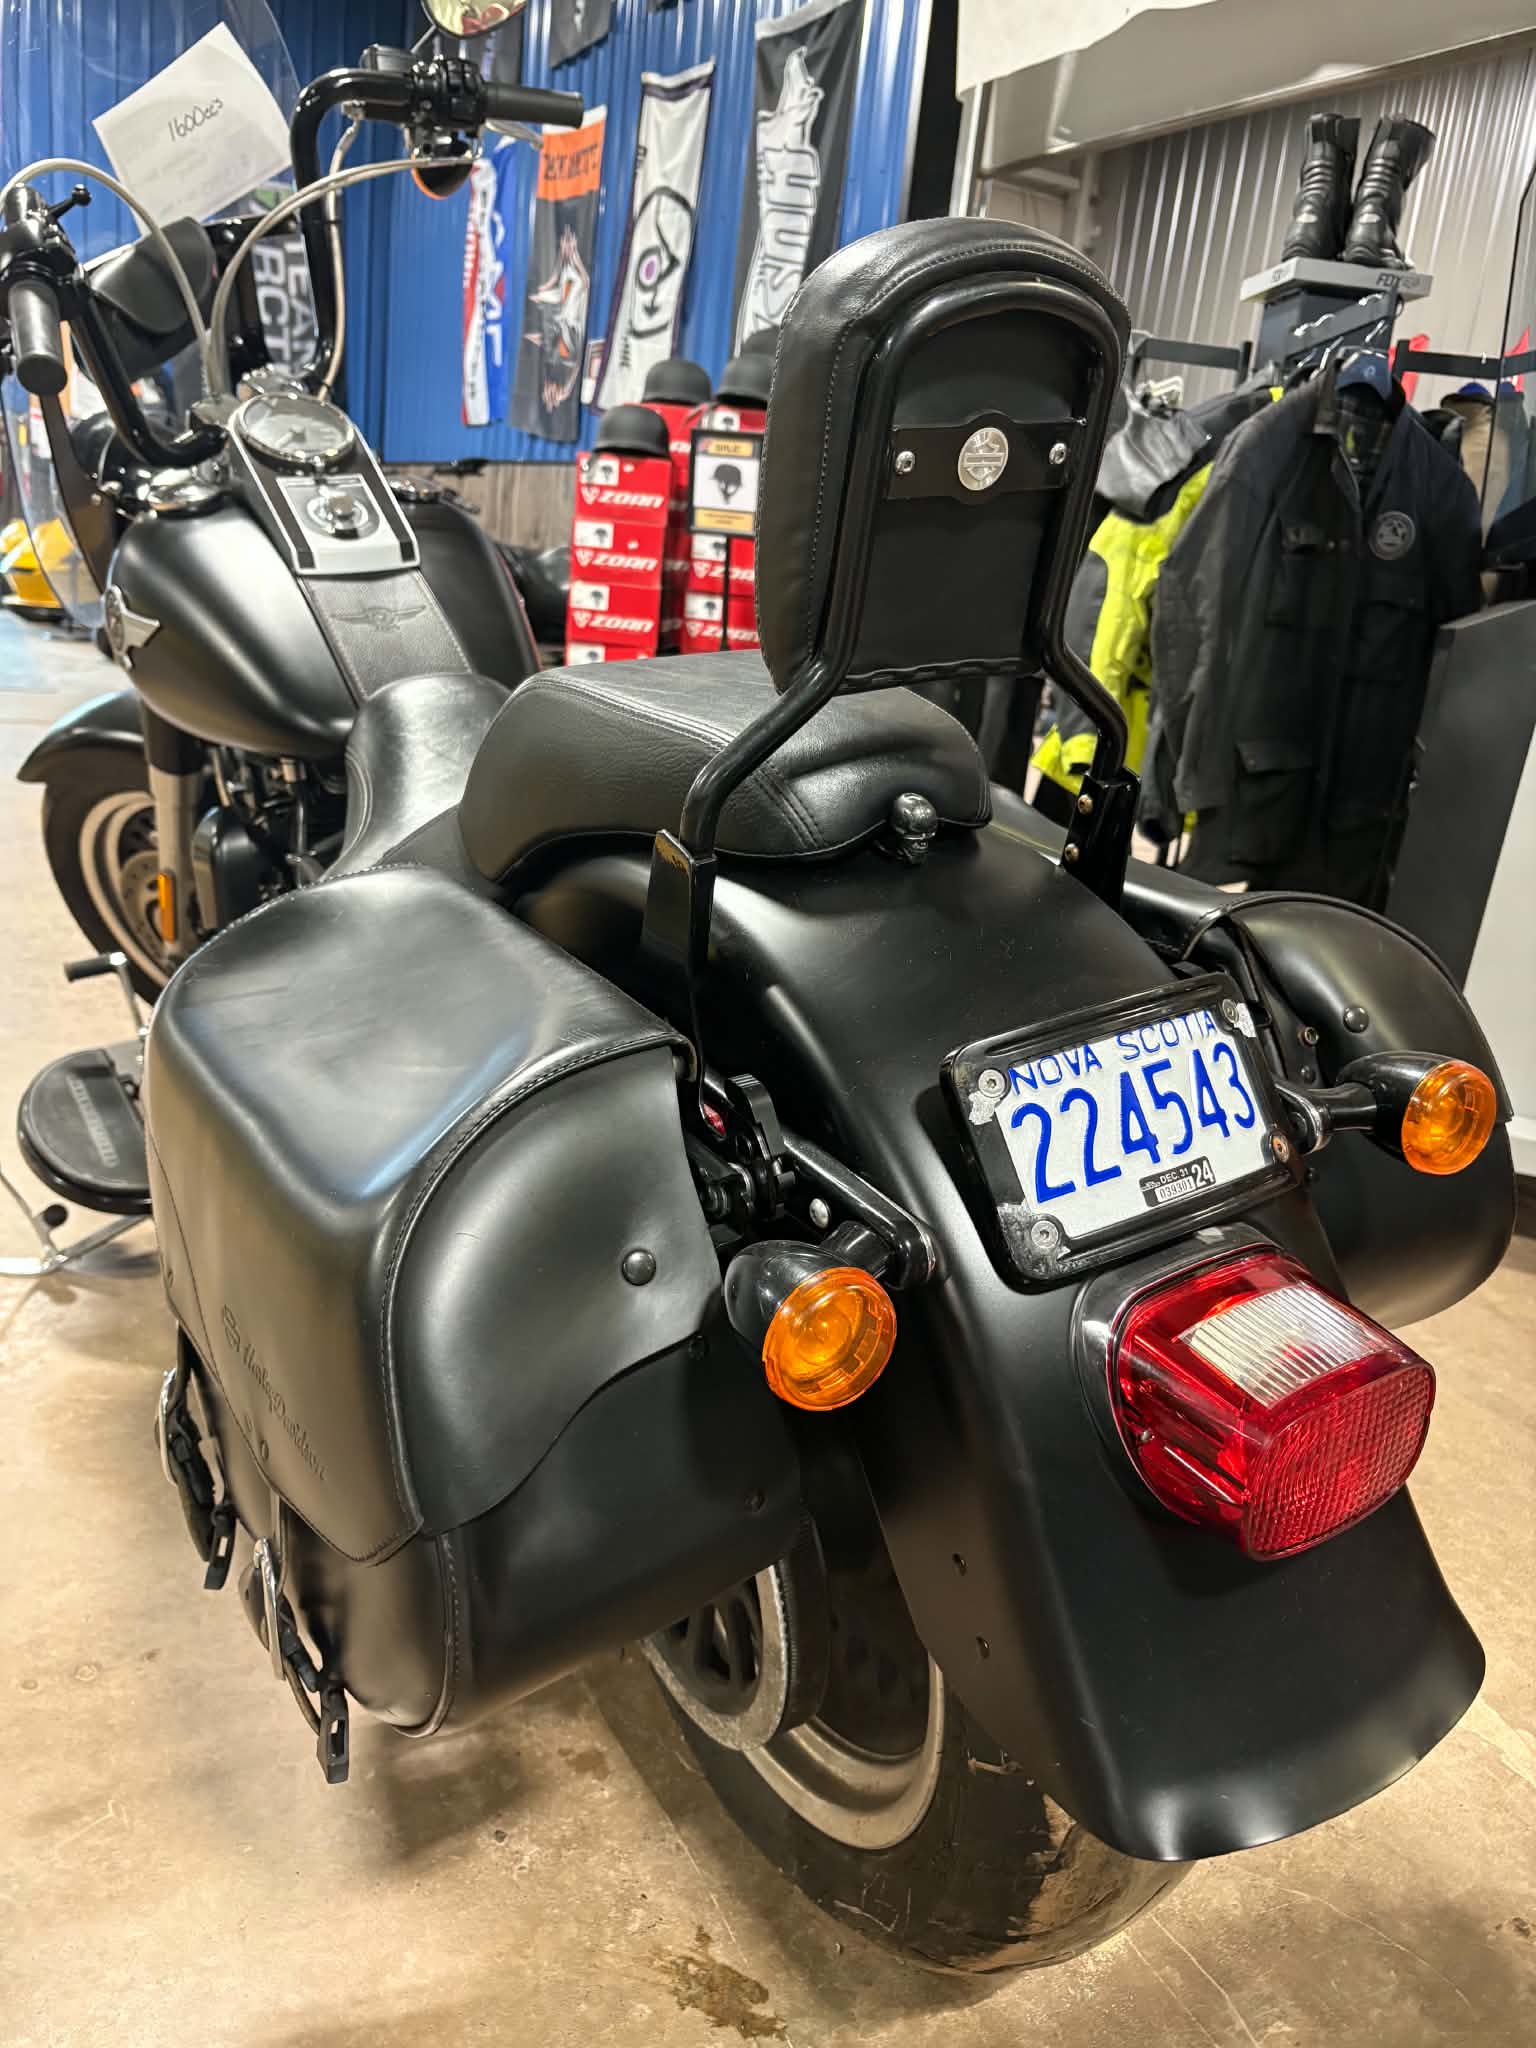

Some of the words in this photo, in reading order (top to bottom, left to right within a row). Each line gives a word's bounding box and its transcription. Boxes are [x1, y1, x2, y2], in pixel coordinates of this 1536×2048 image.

[598, 490, 665, 509] ZOAN
[592, 553, 659, 572] ZOAN
[588, 614, 655, 633] ZOAN
[1007, 1045, 1103, 1096] NOVA
[1115, 1011, 1218, 1061] SCOTIA
[1011, 1042, 1256, 1203] 224543
[1191, 1160, 1215, 1188] 24
[1159, 1177, 1194, 1200] 039301
